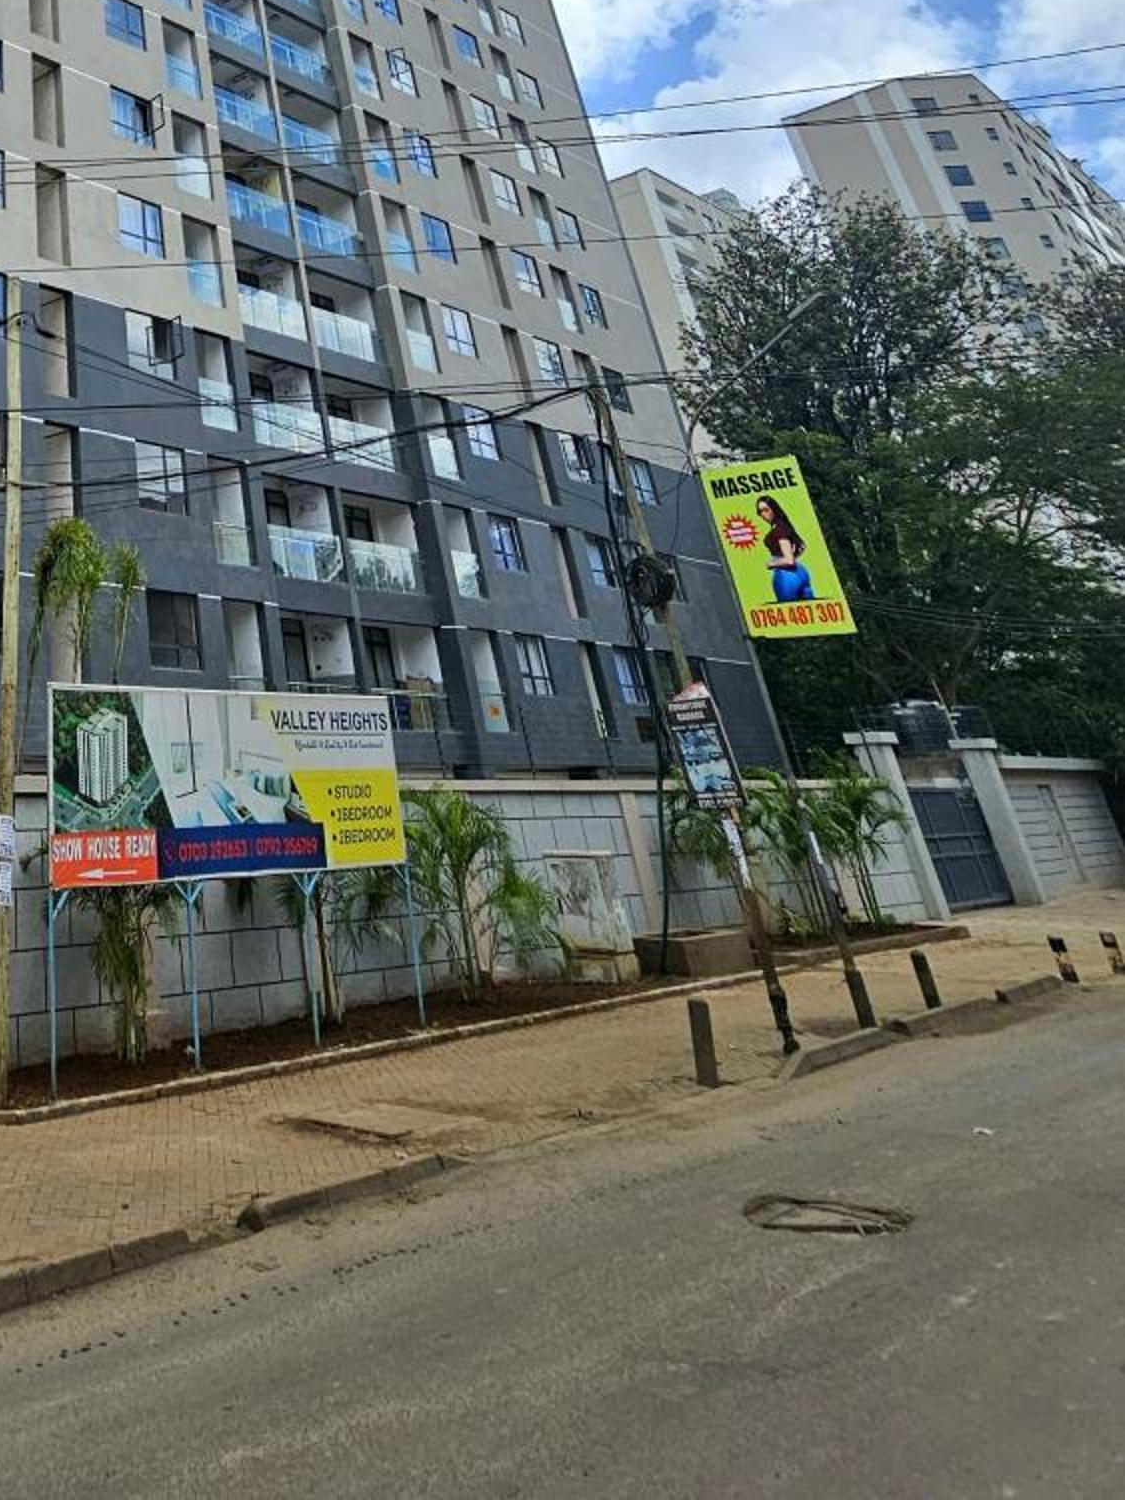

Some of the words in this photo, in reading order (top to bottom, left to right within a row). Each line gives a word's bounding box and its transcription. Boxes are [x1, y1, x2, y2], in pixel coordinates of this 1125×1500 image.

[710, 467, 798, 499] MASSAGE
[749, 606, 787, 629] 0764
[271, 709, 326, 731] VALLEY
[330, 710, 388, 732] HEIGHTS
[334, 783, 372, 799] STUDIO
[52, 838, 82, 863] SHOW
[87, 836, 121, 860] HOUSE
[125, 833, 156, 858] READY
